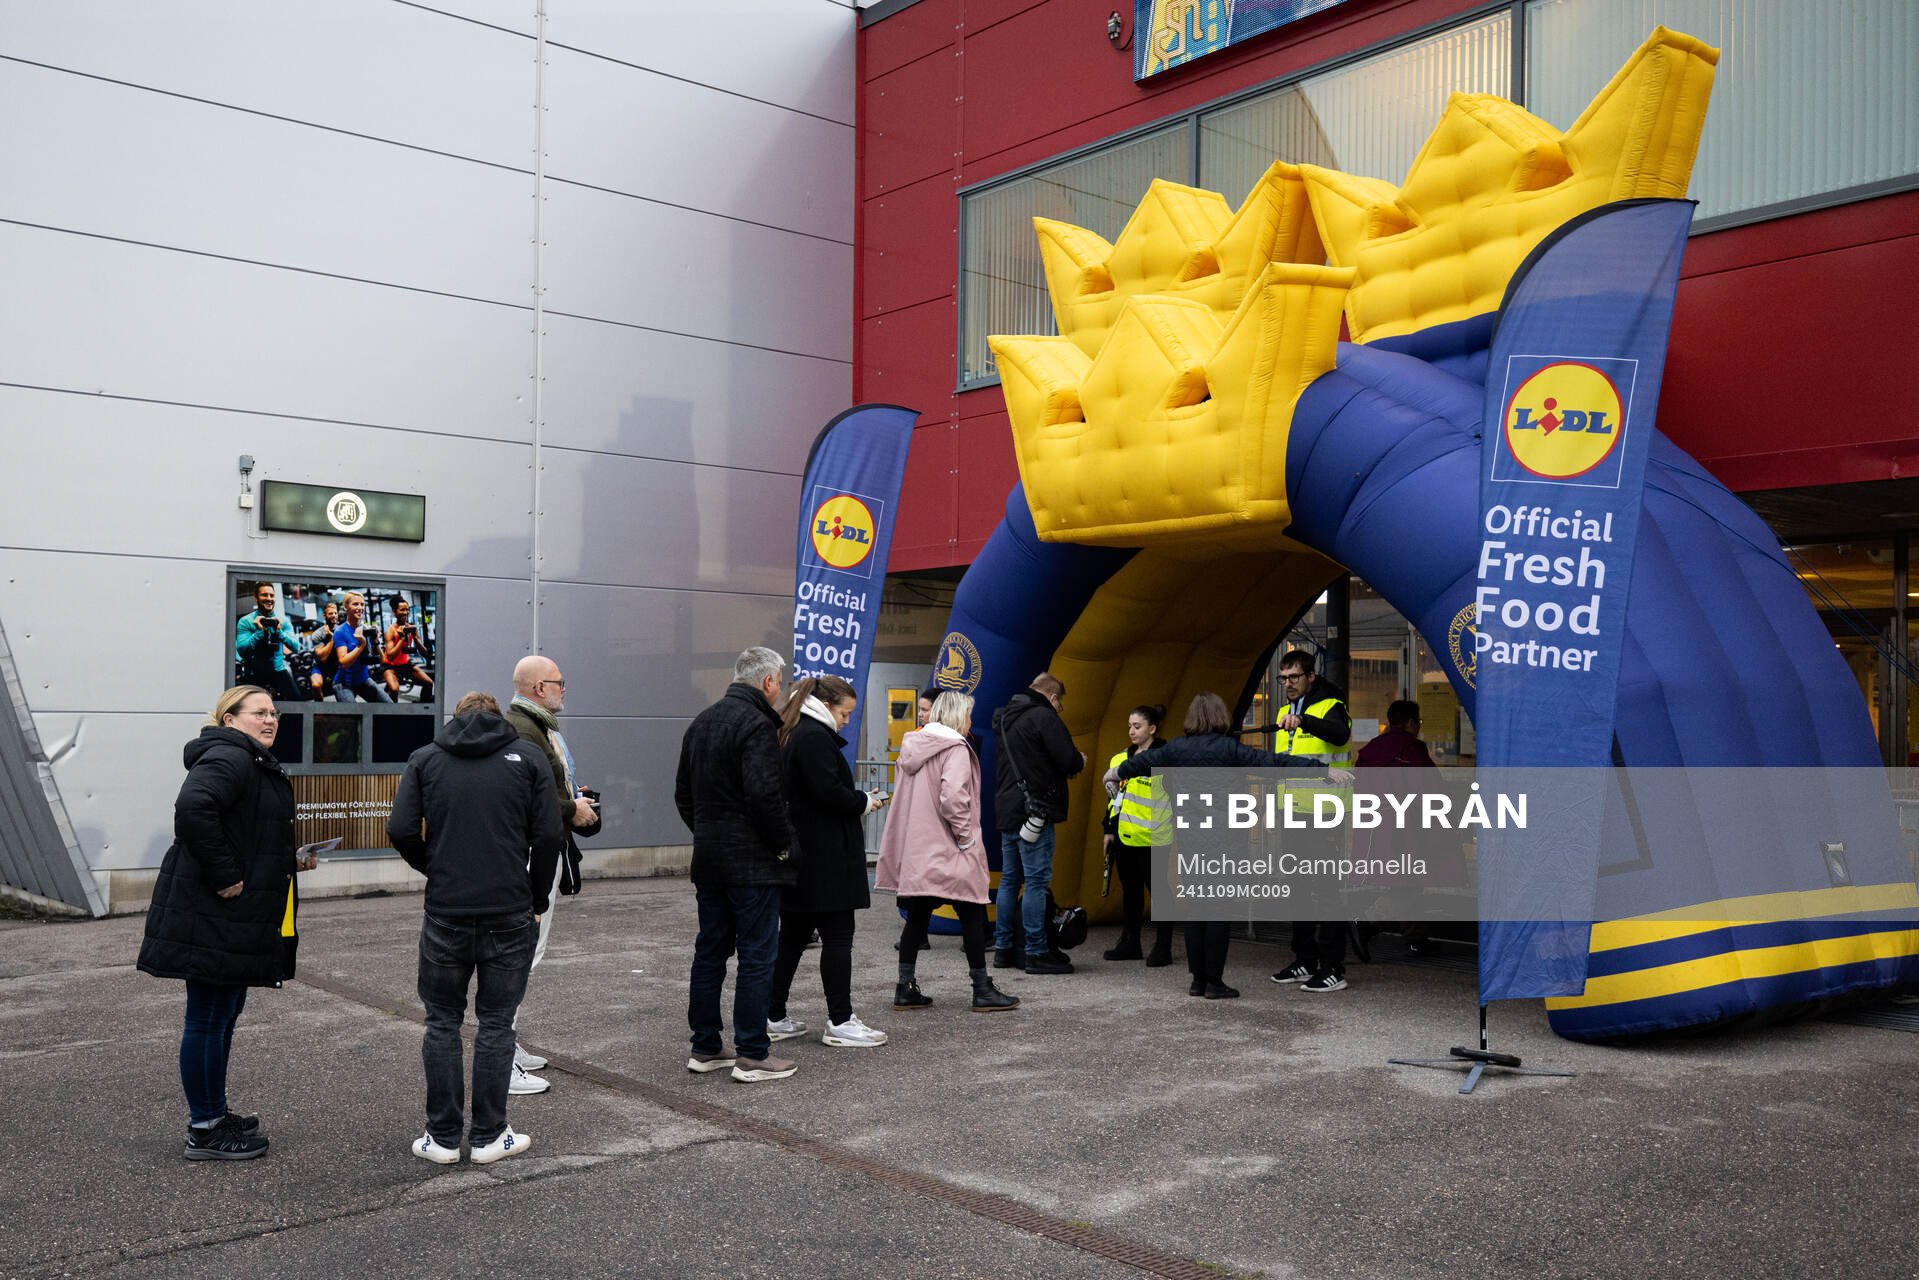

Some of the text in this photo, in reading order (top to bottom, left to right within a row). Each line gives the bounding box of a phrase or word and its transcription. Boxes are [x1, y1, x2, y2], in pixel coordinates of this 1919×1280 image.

[1485, 505, 1612, 542] Official
[1477, 540, 1606, 588] Fresh
[798, 581, 866, 611] Official
[1475, 586, 1600, 636] Food
[794, 603, 861, 640] Fresh
[793, 633, 857, 669] Food
[1475, 632, 1598, 672] Partner
[296, 802, 347, 810] PREMIUMGYM
[349, 810, 392, 818] TRÄNINGSU
